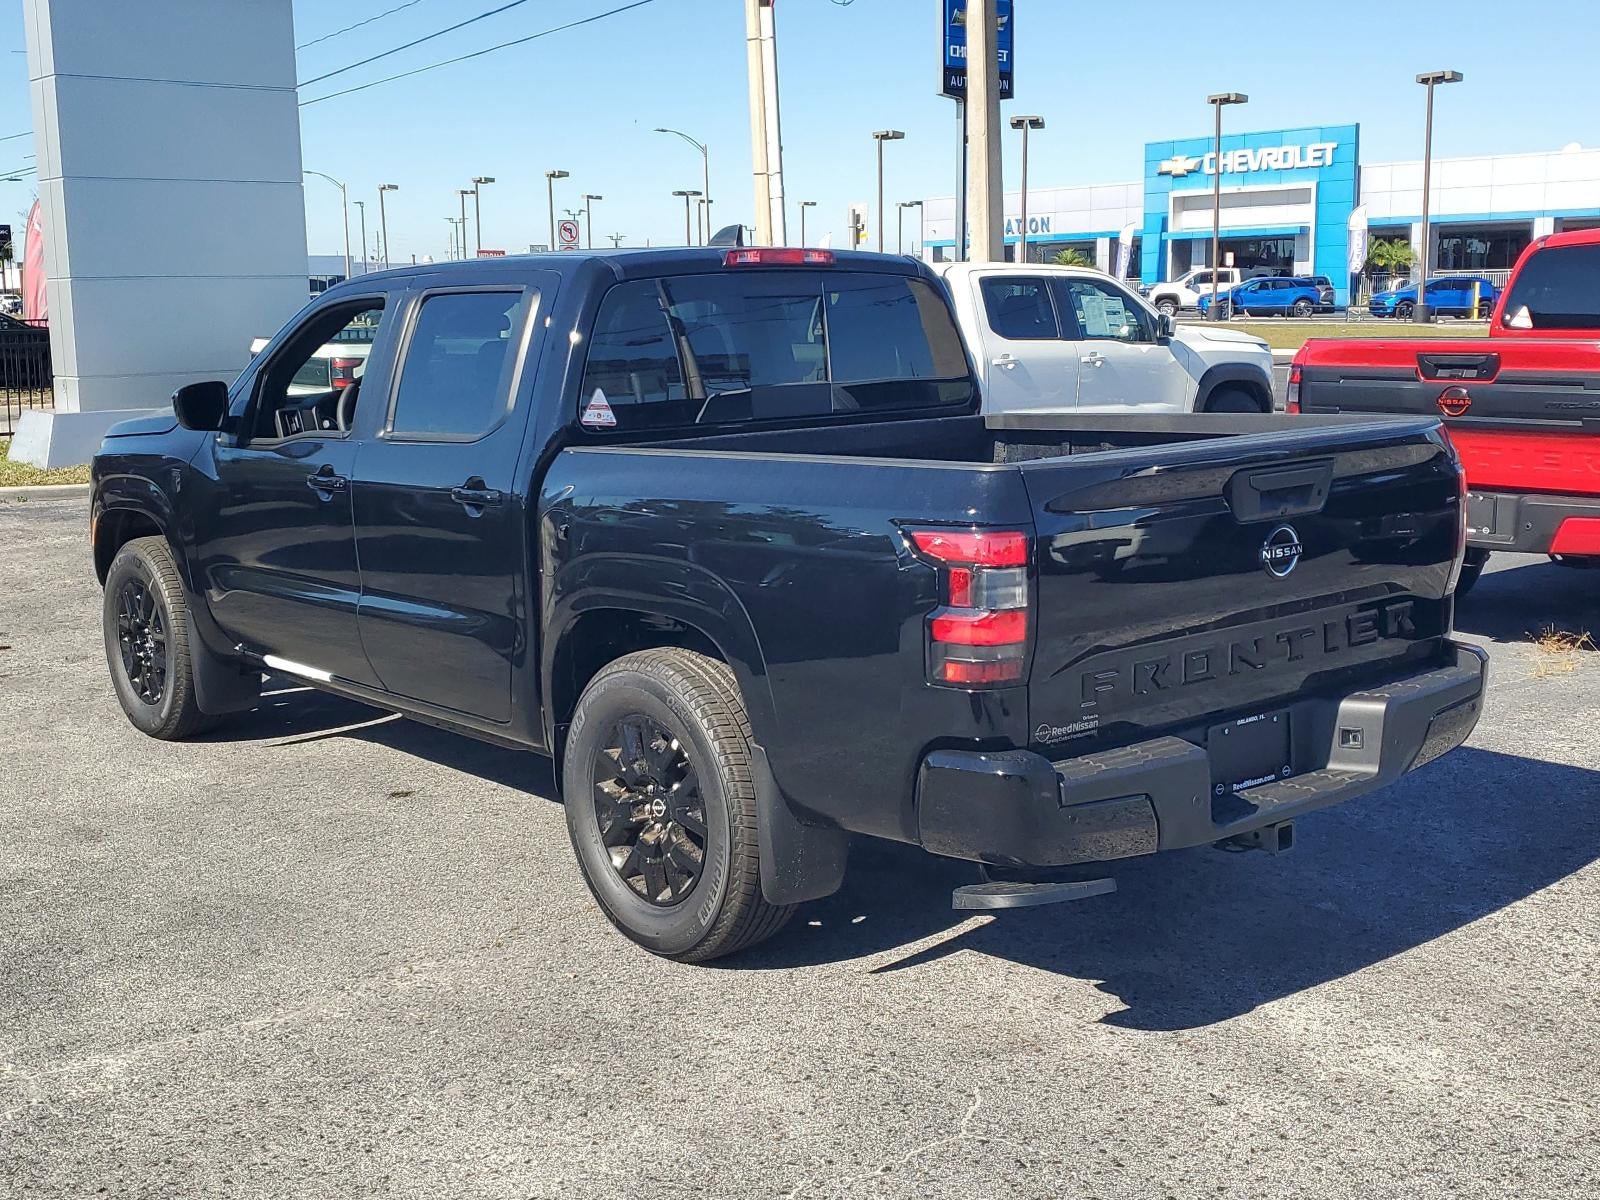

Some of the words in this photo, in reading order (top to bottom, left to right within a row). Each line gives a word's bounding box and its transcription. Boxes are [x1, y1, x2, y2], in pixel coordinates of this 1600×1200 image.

[1202, 142, 1338, 175] CHEVROLET
[1262, 545, 1303, 559] NISSAN
[1080, 601, 1416, 708] FRONTIER
[1051, 720, 1099, 736] ReedNissan
[1232, 774, 1276, 791] ReedNissan.com
